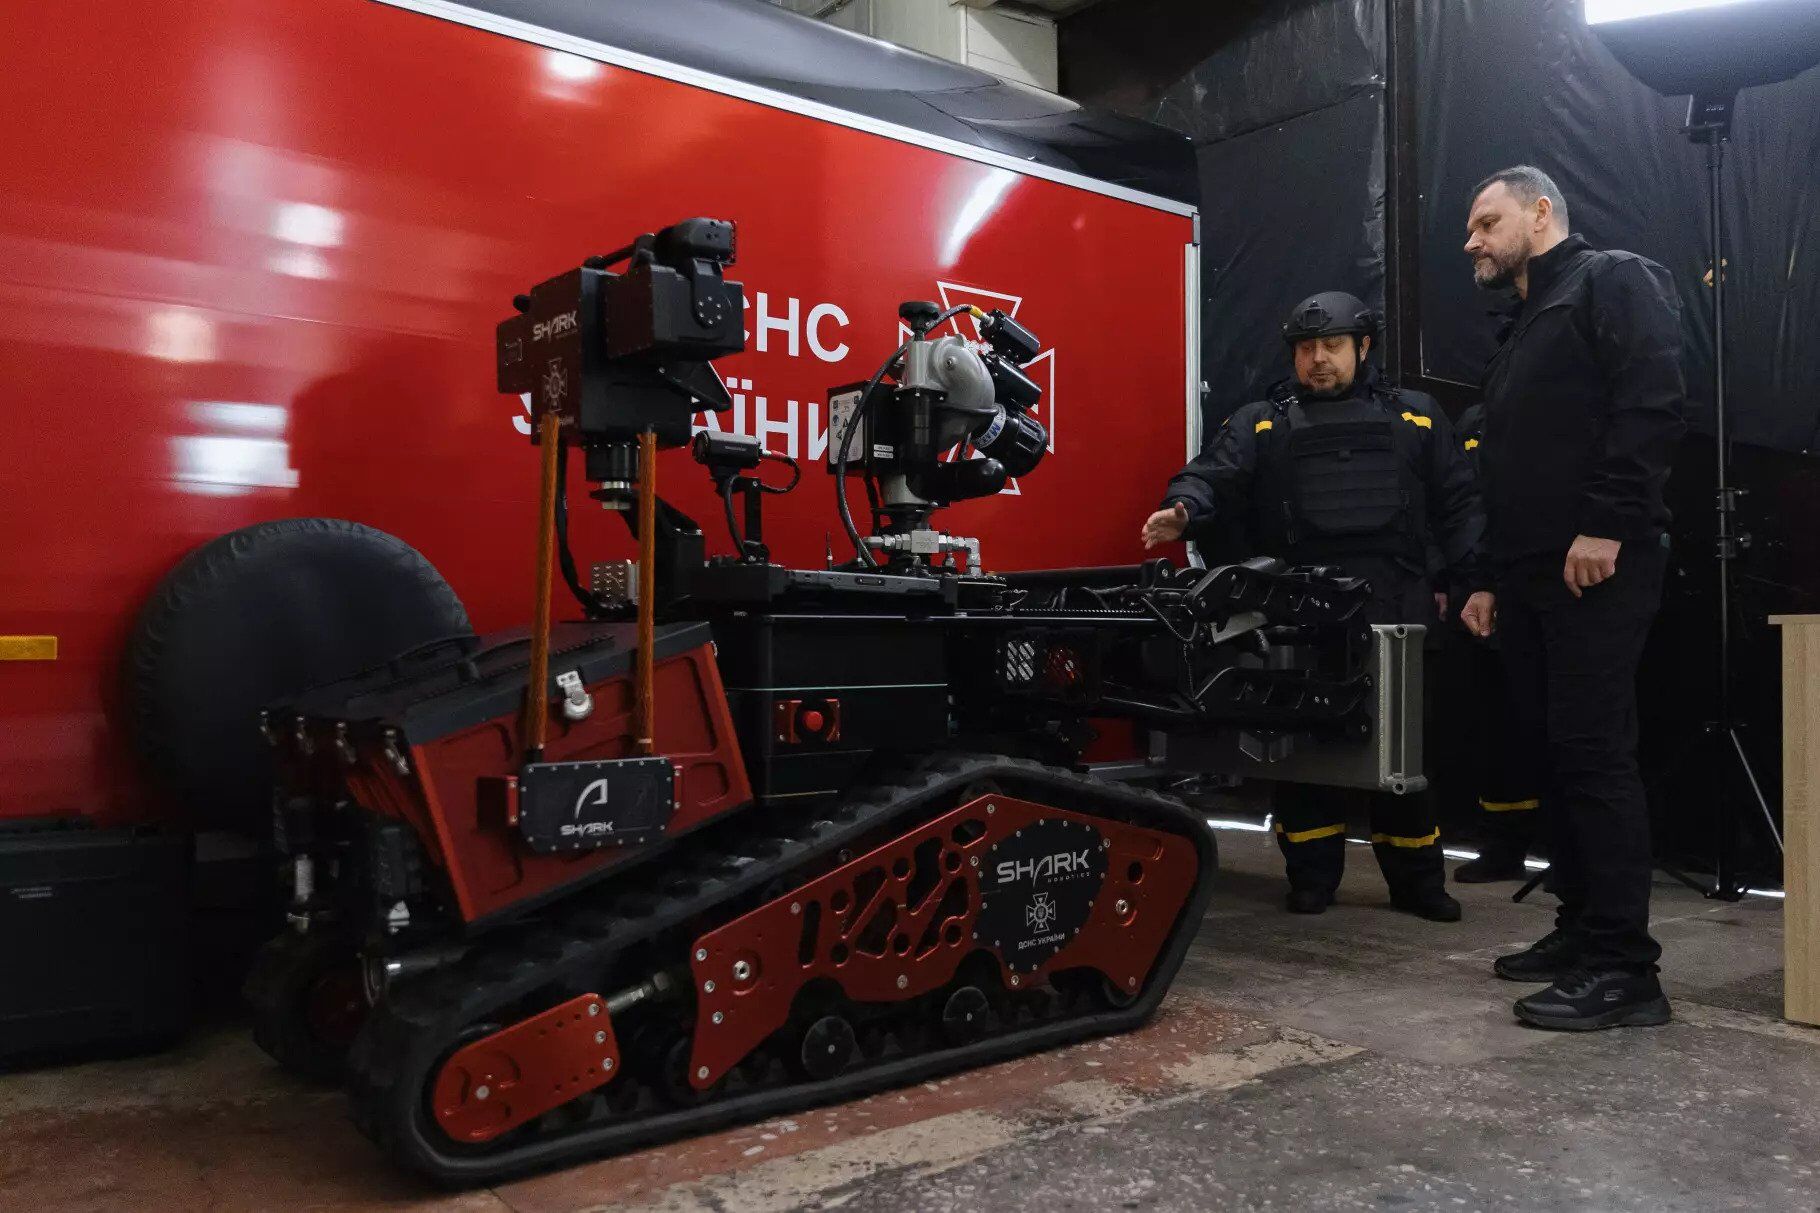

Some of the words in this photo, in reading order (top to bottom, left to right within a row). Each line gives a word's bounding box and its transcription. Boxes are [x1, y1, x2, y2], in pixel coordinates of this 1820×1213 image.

[533, 311, 577, 343] SHARK
[743, 292, 850, 363] НС
[560, 821, 614, 838] SHARK
[997, 849, 1089, 888] SHARK
[1018, 939, 1037, 951] ДСНС
